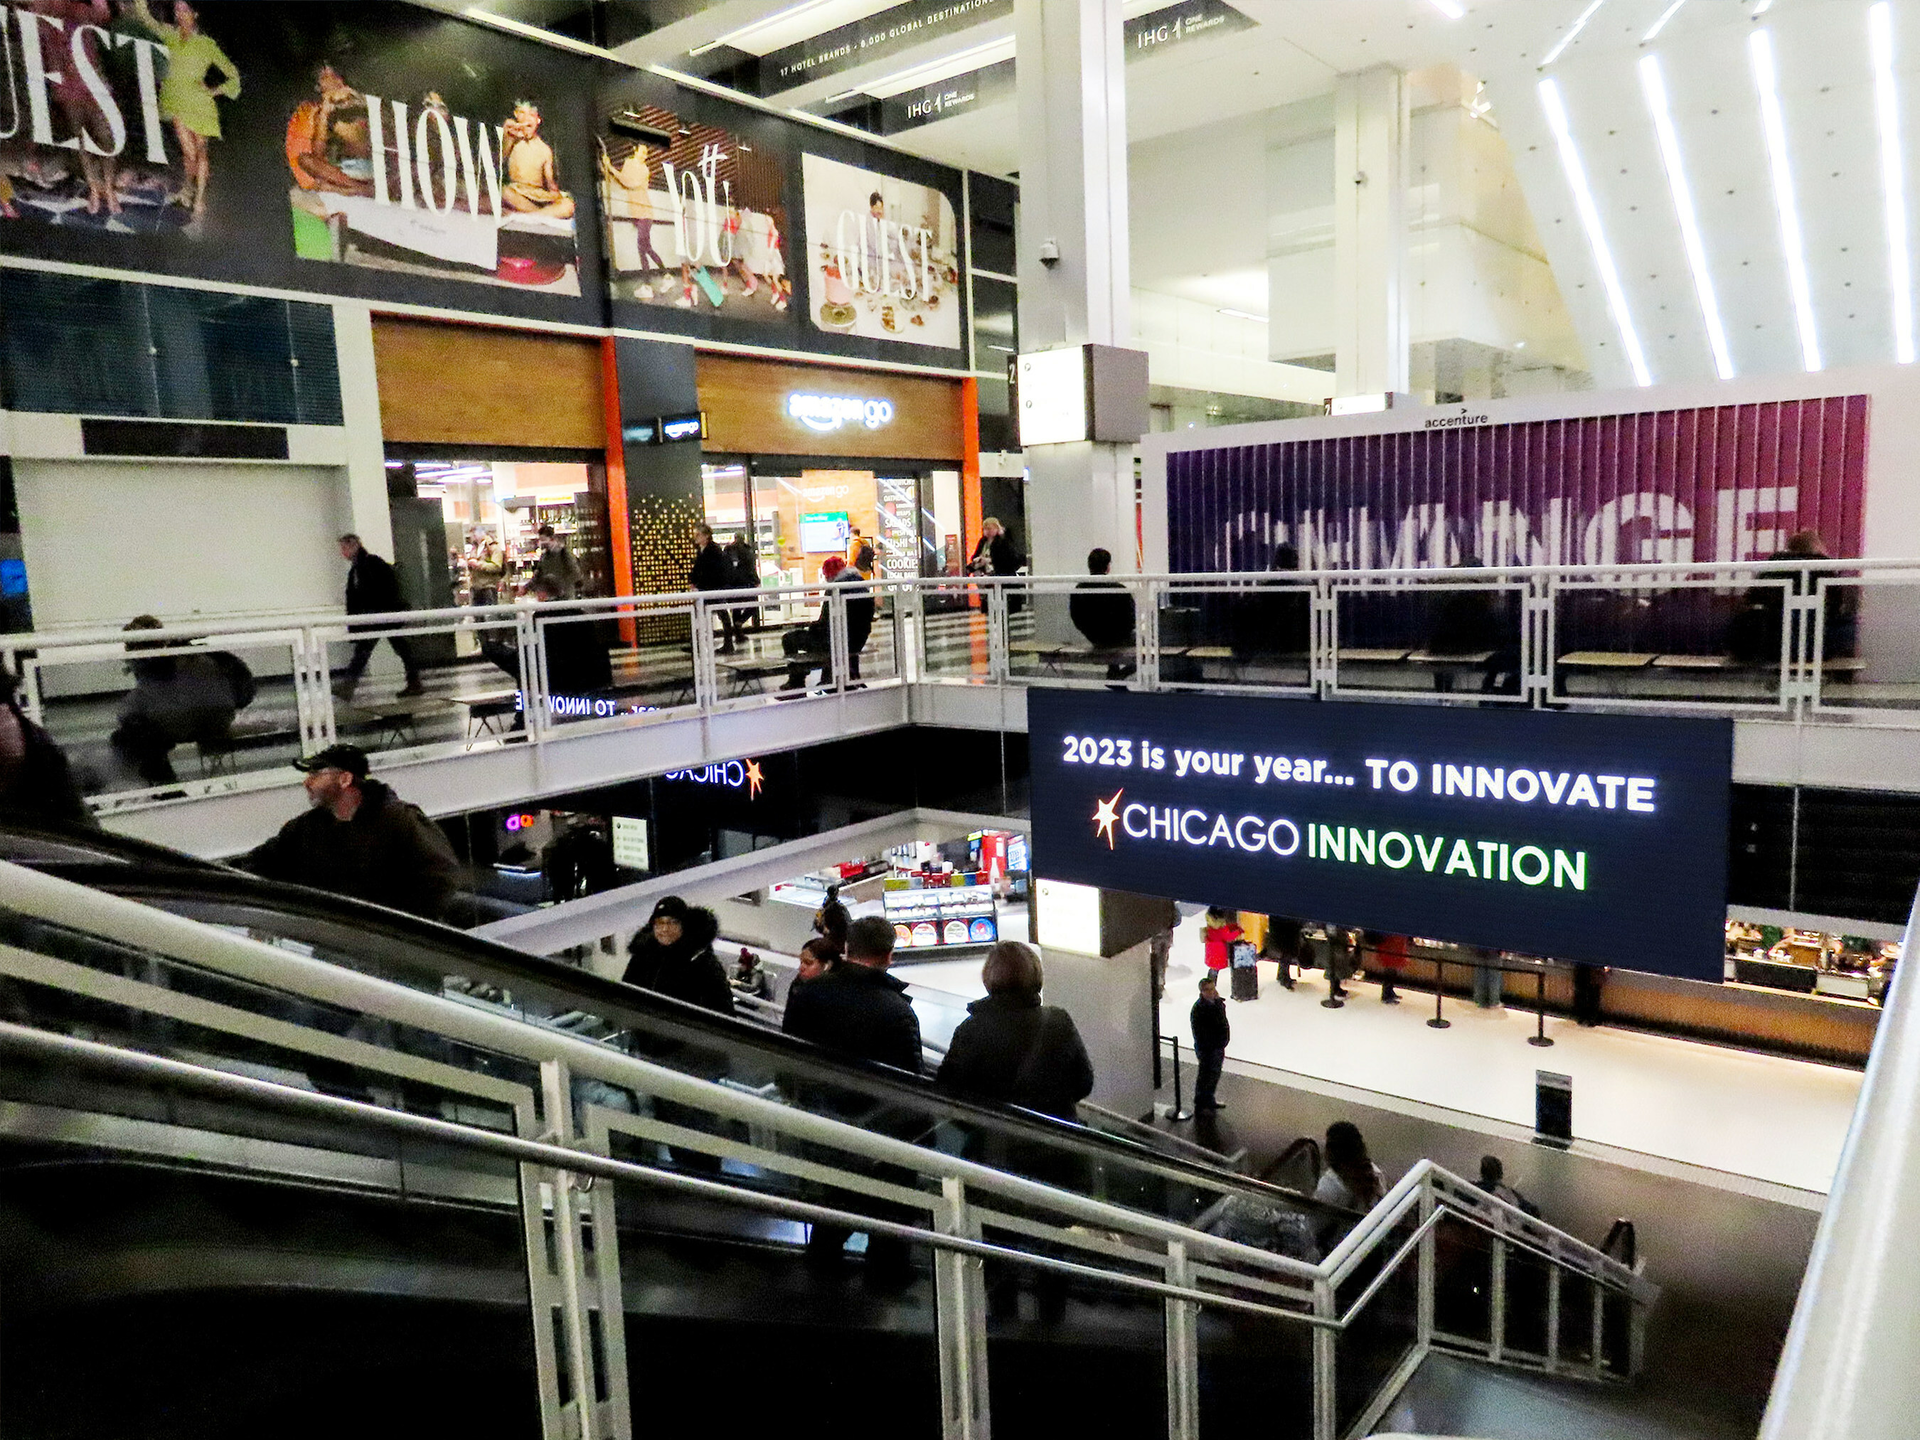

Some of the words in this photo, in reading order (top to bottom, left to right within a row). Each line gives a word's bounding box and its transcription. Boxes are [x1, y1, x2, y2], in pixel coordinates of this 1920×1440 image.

[1185, 14, 1203, 26] ONE
[1185, 15, 1225, 33] REWARDS
[791, 59, 816, 74] HOTEL
[819, 46, 850, 64] BRANDS
[889, 19, 923, 38] GLOBAL
[927, 0, 994, 25] DESTINATION
[1137, 26, 1168, 49] IHG
[907, 100, 932, 119] IHG
[365, 94, 504, 226] HOW
[837, 210, 933, 302] GUEST
[864, 400, 892, 428] go
[1425, 413, 1488, 428] accenture
[1062, 736, 1133, 767] 2023
[1142, 741, 1165, 770] is
[1174, 749, 1244, 777] your
[1254, 755, 1354, 785] year...
[1365, 758, 1419, 792] TO
[1432, 763, 1655, 812] INNOVATE
[1122, 803, 1299, 856] CHICAGO
[1308, 822, 1586, 891] INNOVATION
